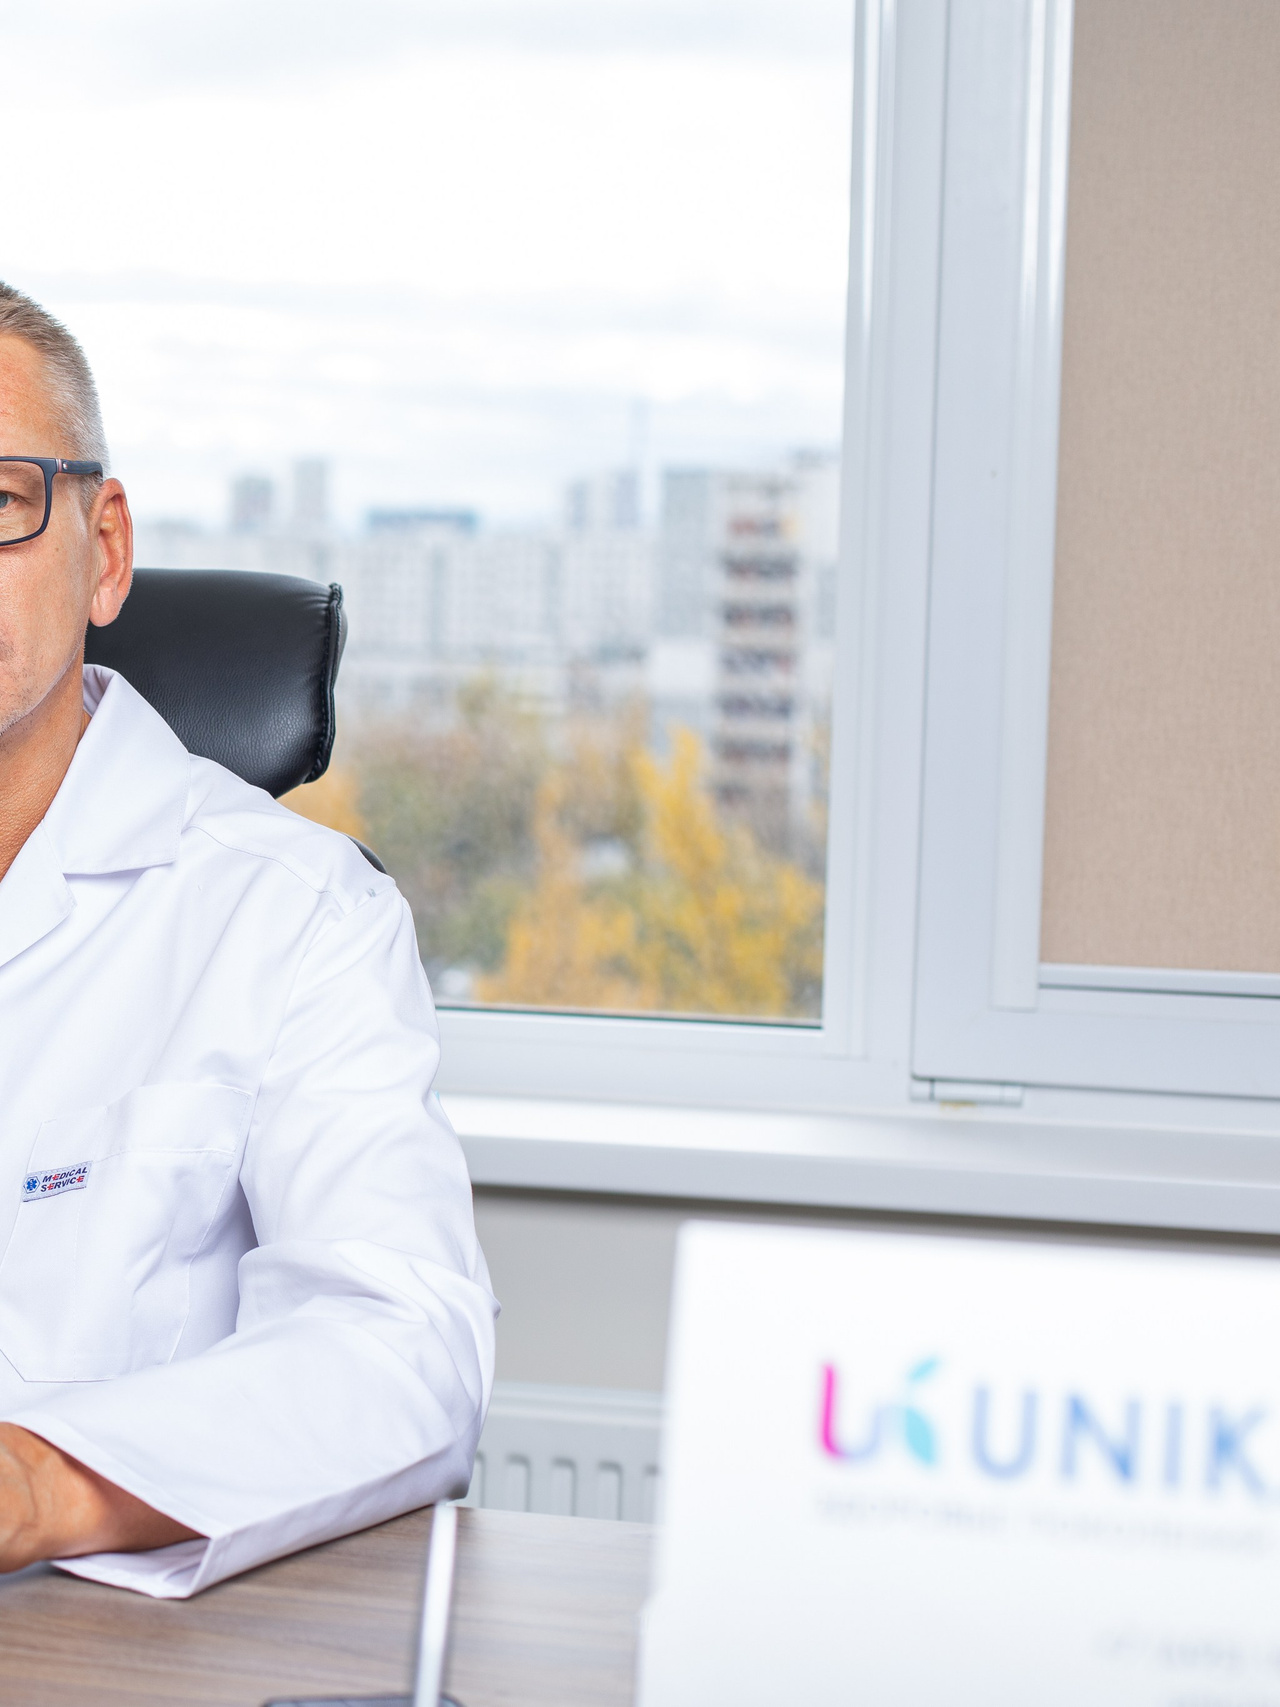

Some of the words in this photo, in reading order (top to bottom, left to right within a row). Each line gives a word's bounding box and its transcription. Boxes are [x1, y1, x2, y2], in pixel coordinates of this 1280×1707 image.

[42, 1166, 88, 1182] MEDICAL
[40, 1175, 85, 1192] SERVICE
[969, 1382, 1280, 1503] UNIK
